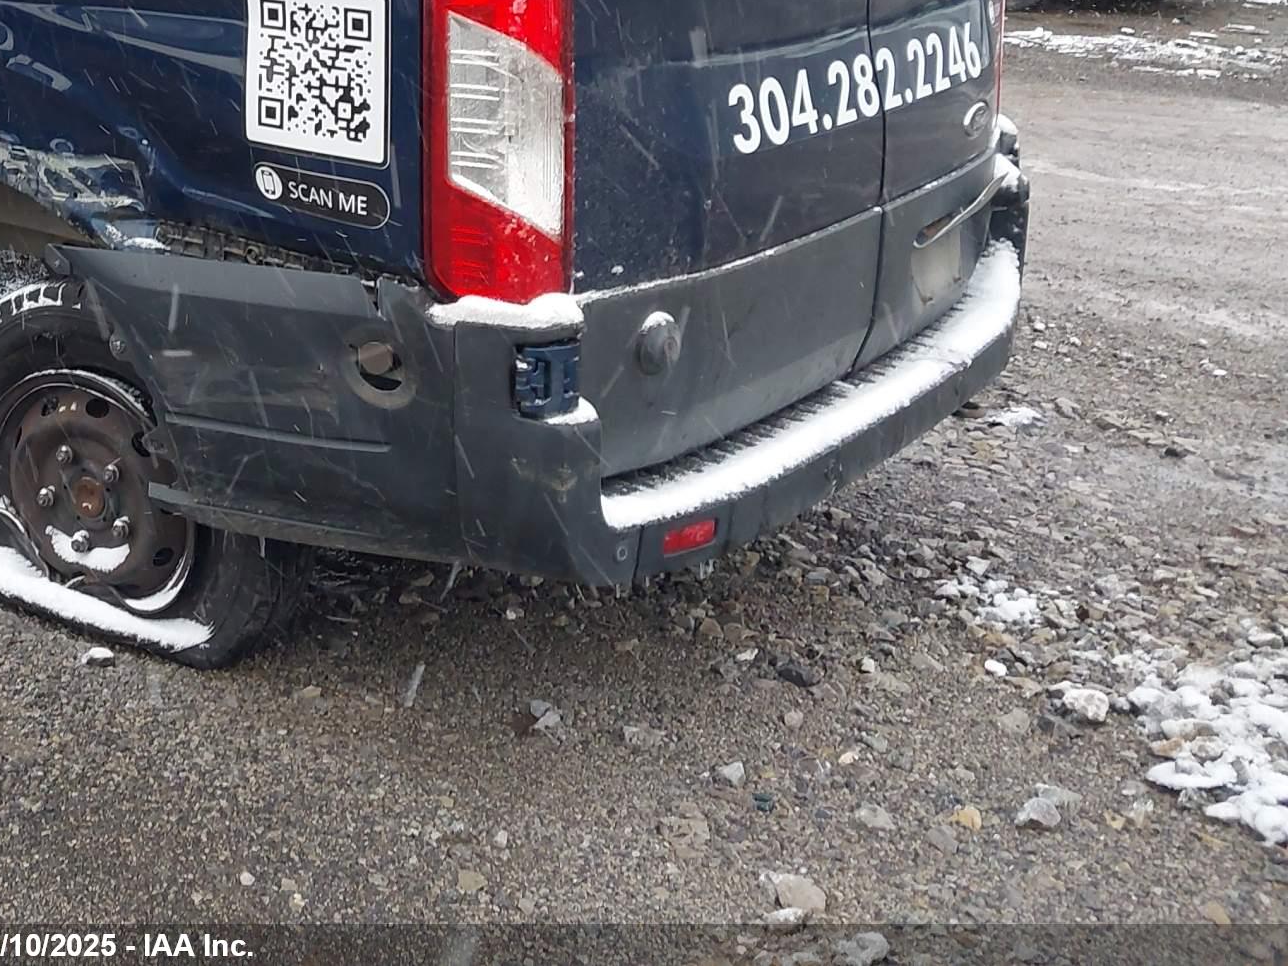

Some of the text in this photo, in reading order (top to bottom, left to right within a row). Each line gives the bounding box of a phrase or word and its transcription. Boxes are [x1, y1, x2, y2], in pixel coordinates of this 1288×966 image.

[728, 22, 981, 154] 304.282.2246
[288, 181, 368, 216] SCAN ME
